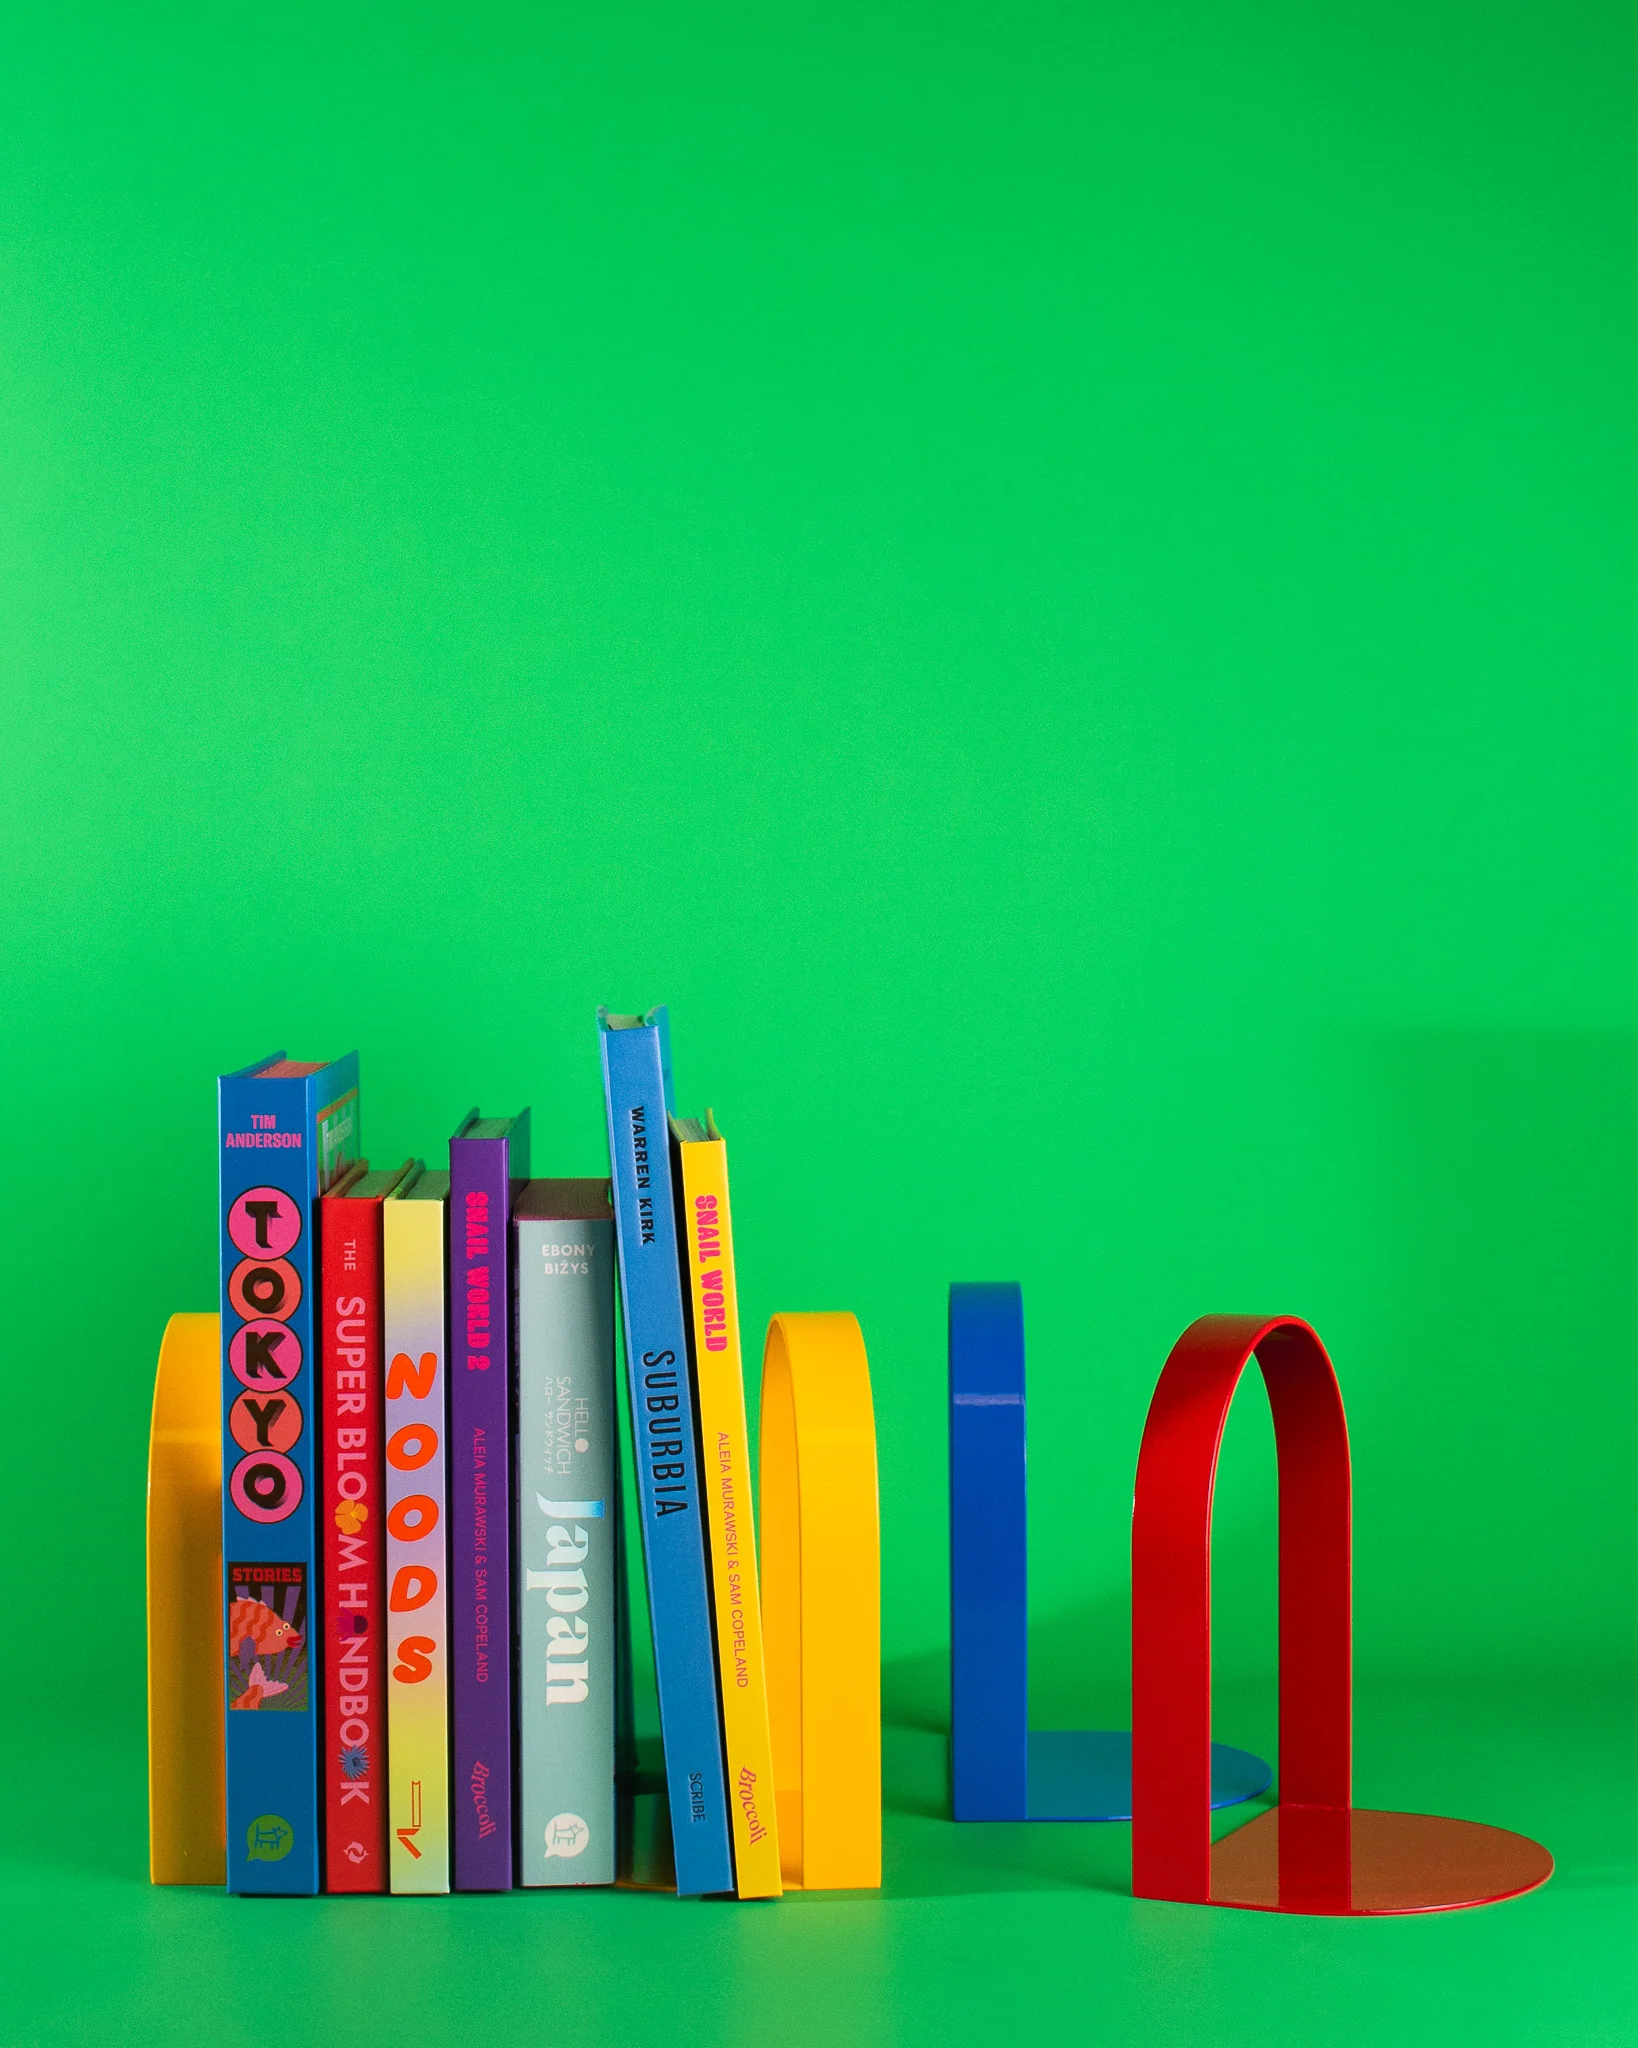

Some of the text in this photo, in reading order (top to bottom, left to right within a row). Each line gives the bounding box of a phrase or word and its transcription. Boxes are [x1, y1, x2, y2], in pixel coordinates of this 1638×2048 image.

[225, 1132, 302, 1148] ANDERSON
[250, 1114, 276, 1130] TIM
[630, 1106, 656, 1245] WARREN KIRK
[465, 1191, 491, 1371] SNAIL WORLD 2
[541, 1245, 596, 1257] EBONY
[544, 1260, 589, 1275] BIŽYS
[695, 1195, 728, 1352] SNAIL WORLD
[241, 1200, 288, 1511] TOKYO
[544, 1376, 554, 1405] ハロー
[556, 1376, 572, 1475] SANDWICH
[642, 1350, 689, 1517] SUBURBIA
[232, 1566, 303, 1583] STORIES
[335, 1239, 370, 1805] THE SUPER BLOM HNDBOK
[386, 1352, 439, 1684] NOODS
[473, 1427, 488, 1683] ALEIA MURAWSKI & SAM COPELAND
[718, 1432, 749, 1688] ALEIA MURAWSKI & SAM COPELAND
[527, 1491, 606, 1706] Japan
[472, 1761, 497, 1840] Broccoli
[689, 1772, 706, 1823] SCRIBE
[739, 1766, 768, 1846] Broccoli
